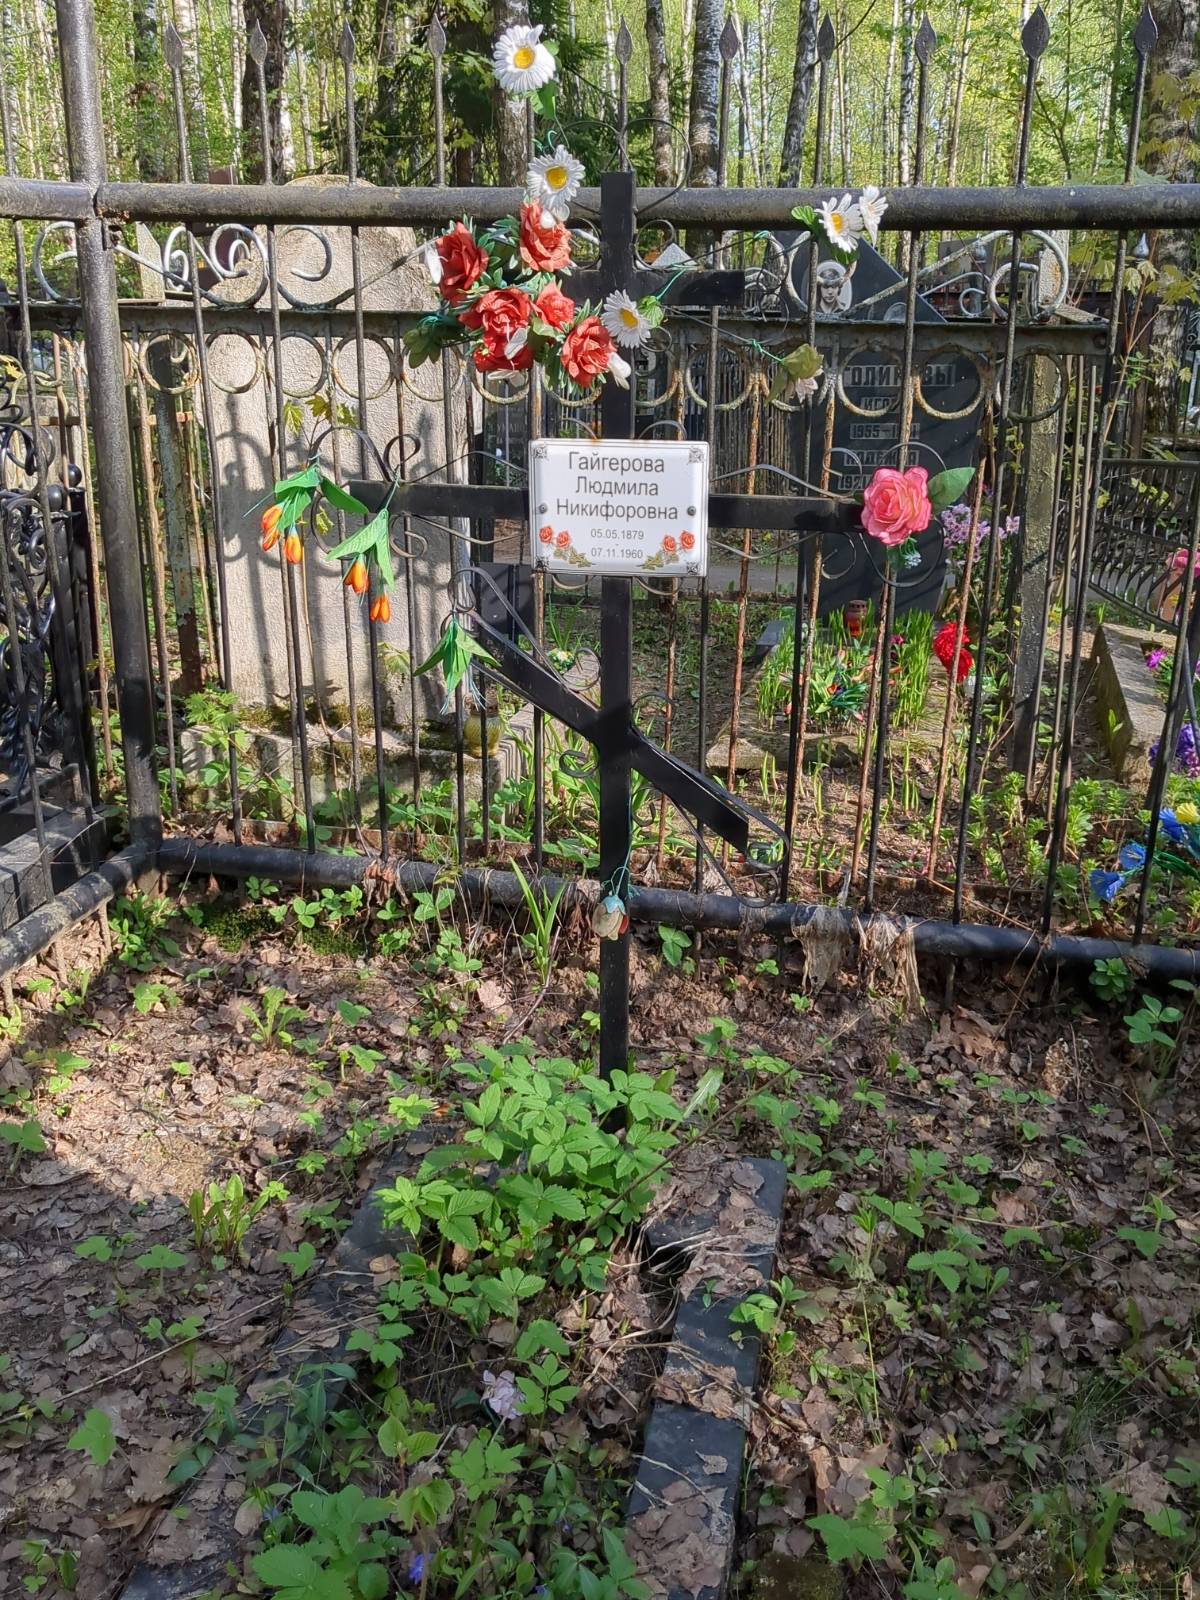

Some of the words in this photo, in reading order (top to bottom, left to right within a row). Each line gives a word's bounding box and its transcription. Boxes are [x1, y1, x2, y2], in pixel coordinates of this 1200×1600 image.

[568, 451, 665, 476] Гайгерова
[575, 475, 659, 497] Людмила
[556, 498, 678, 522] Никифоровна
[590, 528, 645, 541] 05.05.1879
[590, 547, 644, 560] 07.11.1960
